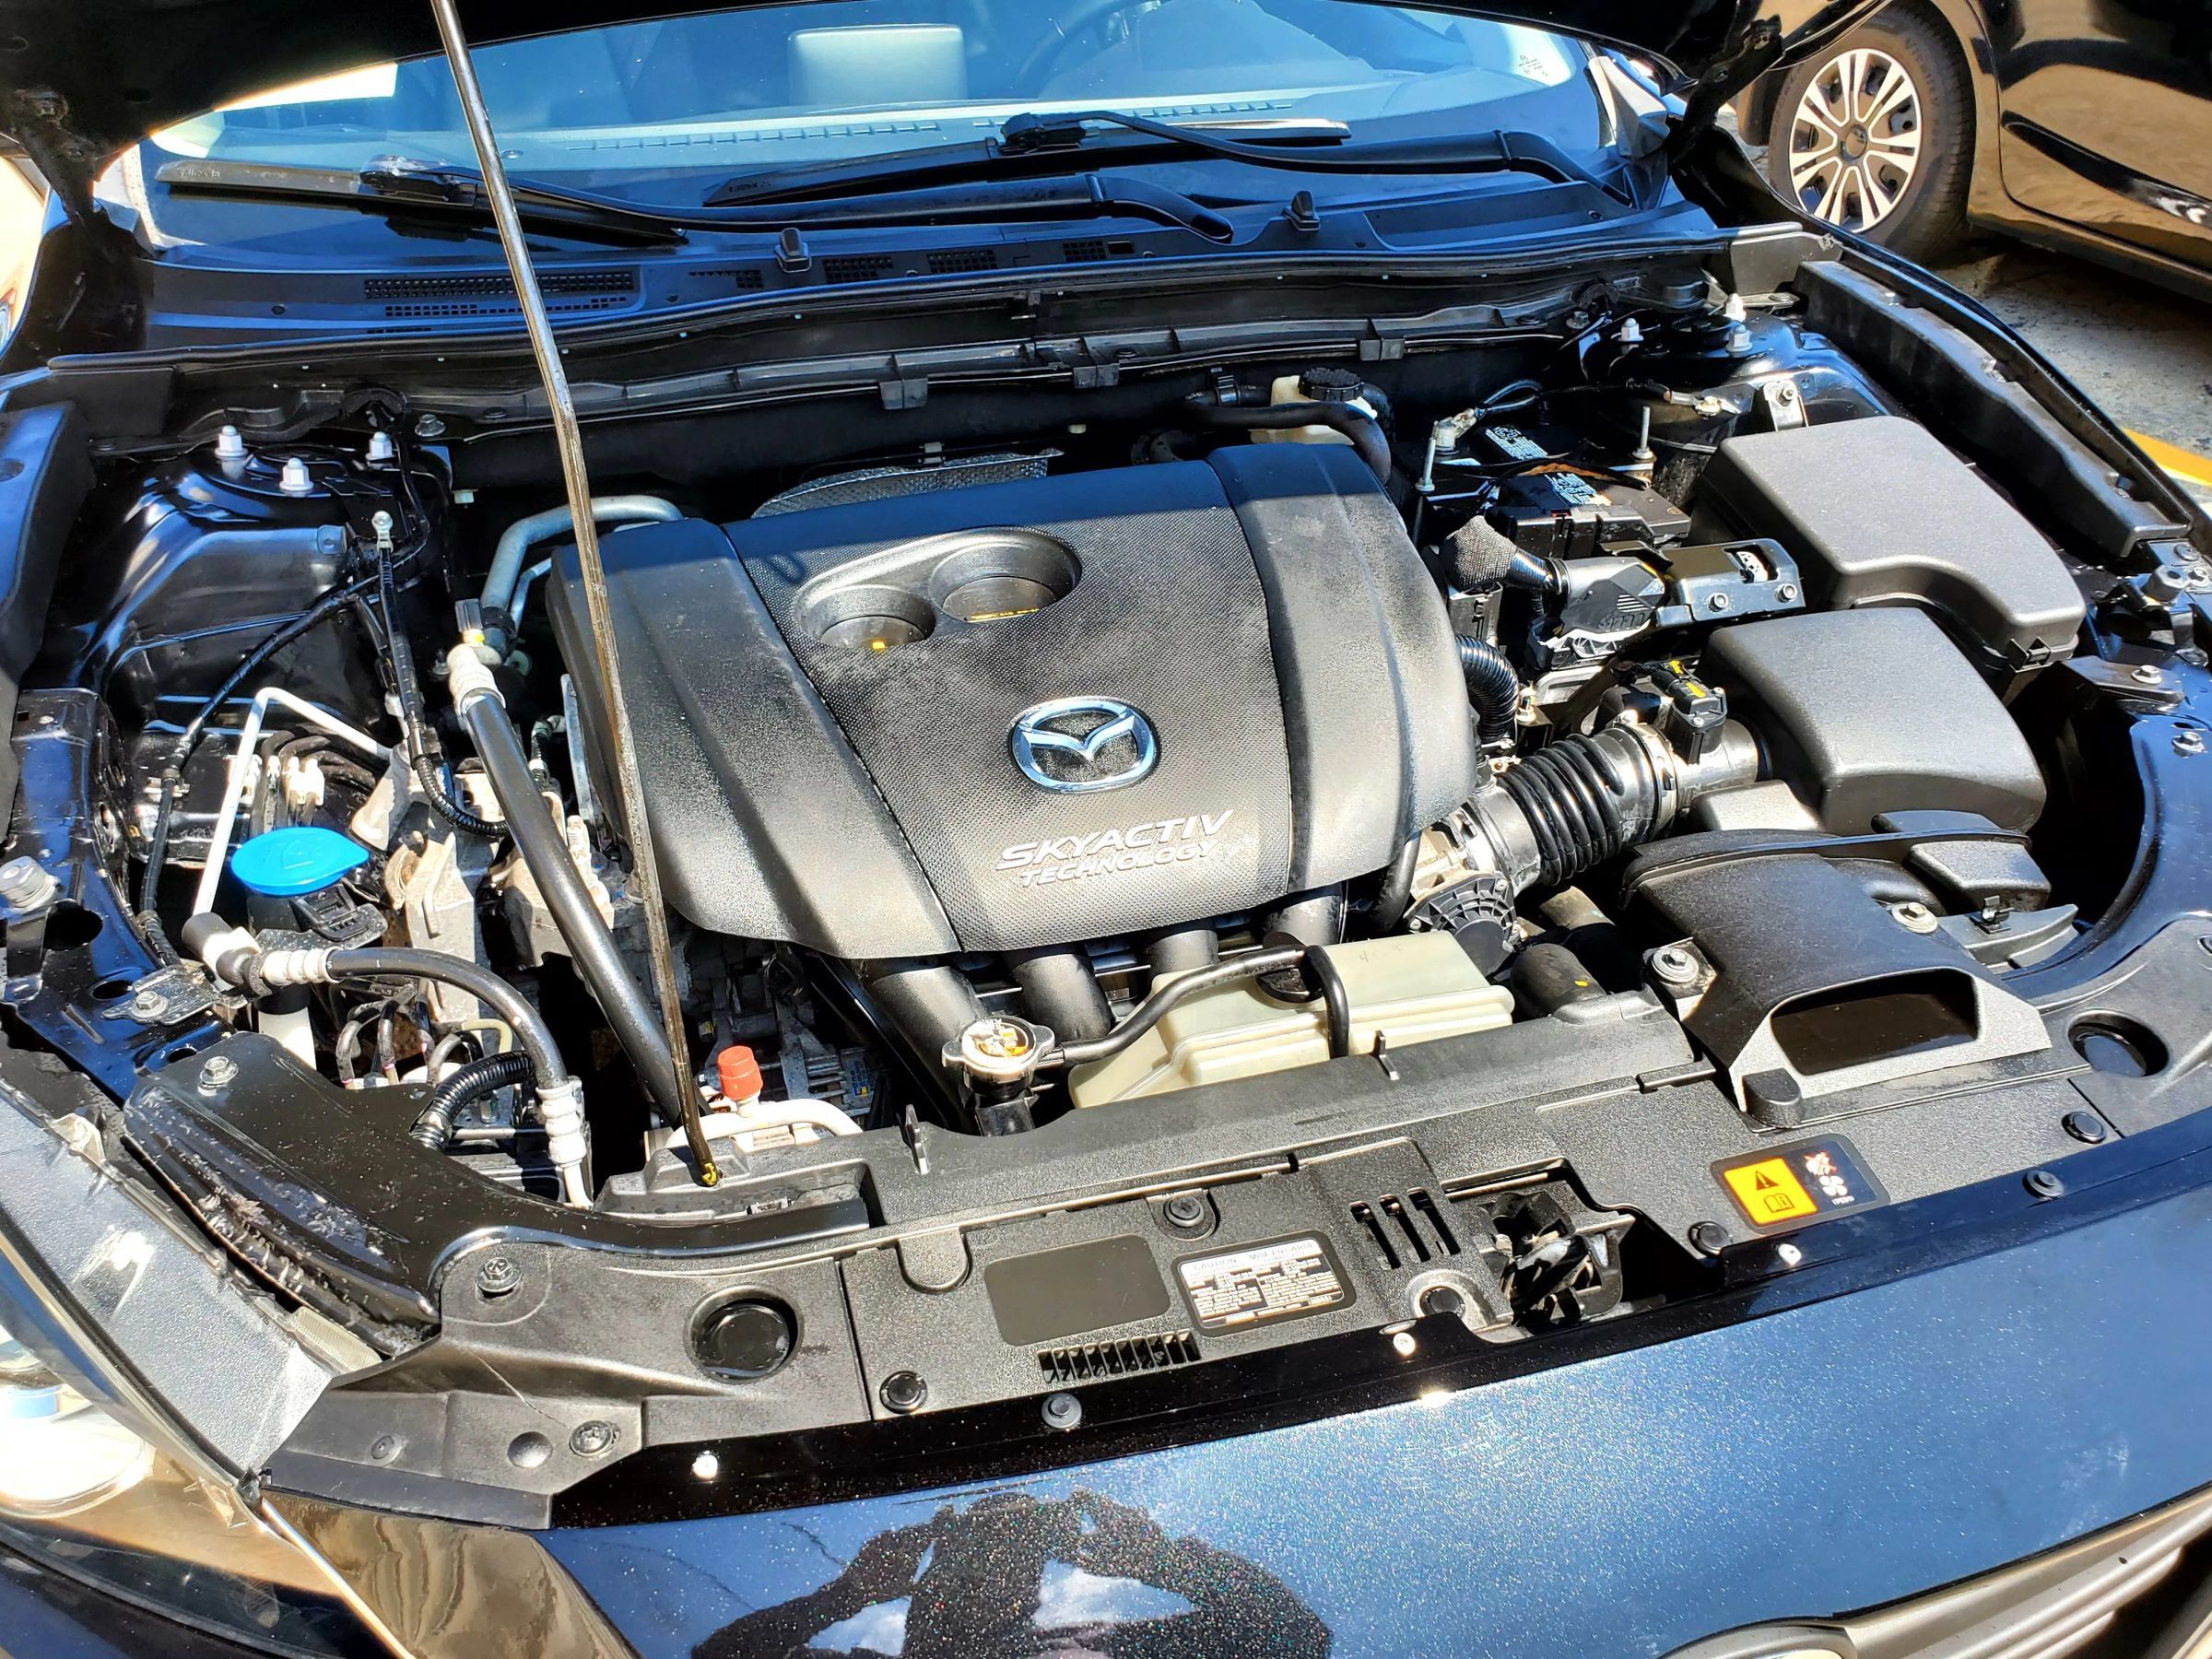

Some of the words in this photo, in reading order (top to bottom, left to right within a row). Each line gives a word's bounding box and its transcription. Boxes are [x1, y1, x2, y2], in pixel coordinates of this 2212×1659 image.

[995, 809, 1234, 870] SKYACTIV
[1020, 838, 1221, 888] TECHNOLOGY
[1193, 1258, 1237, 1270] CAUTION
